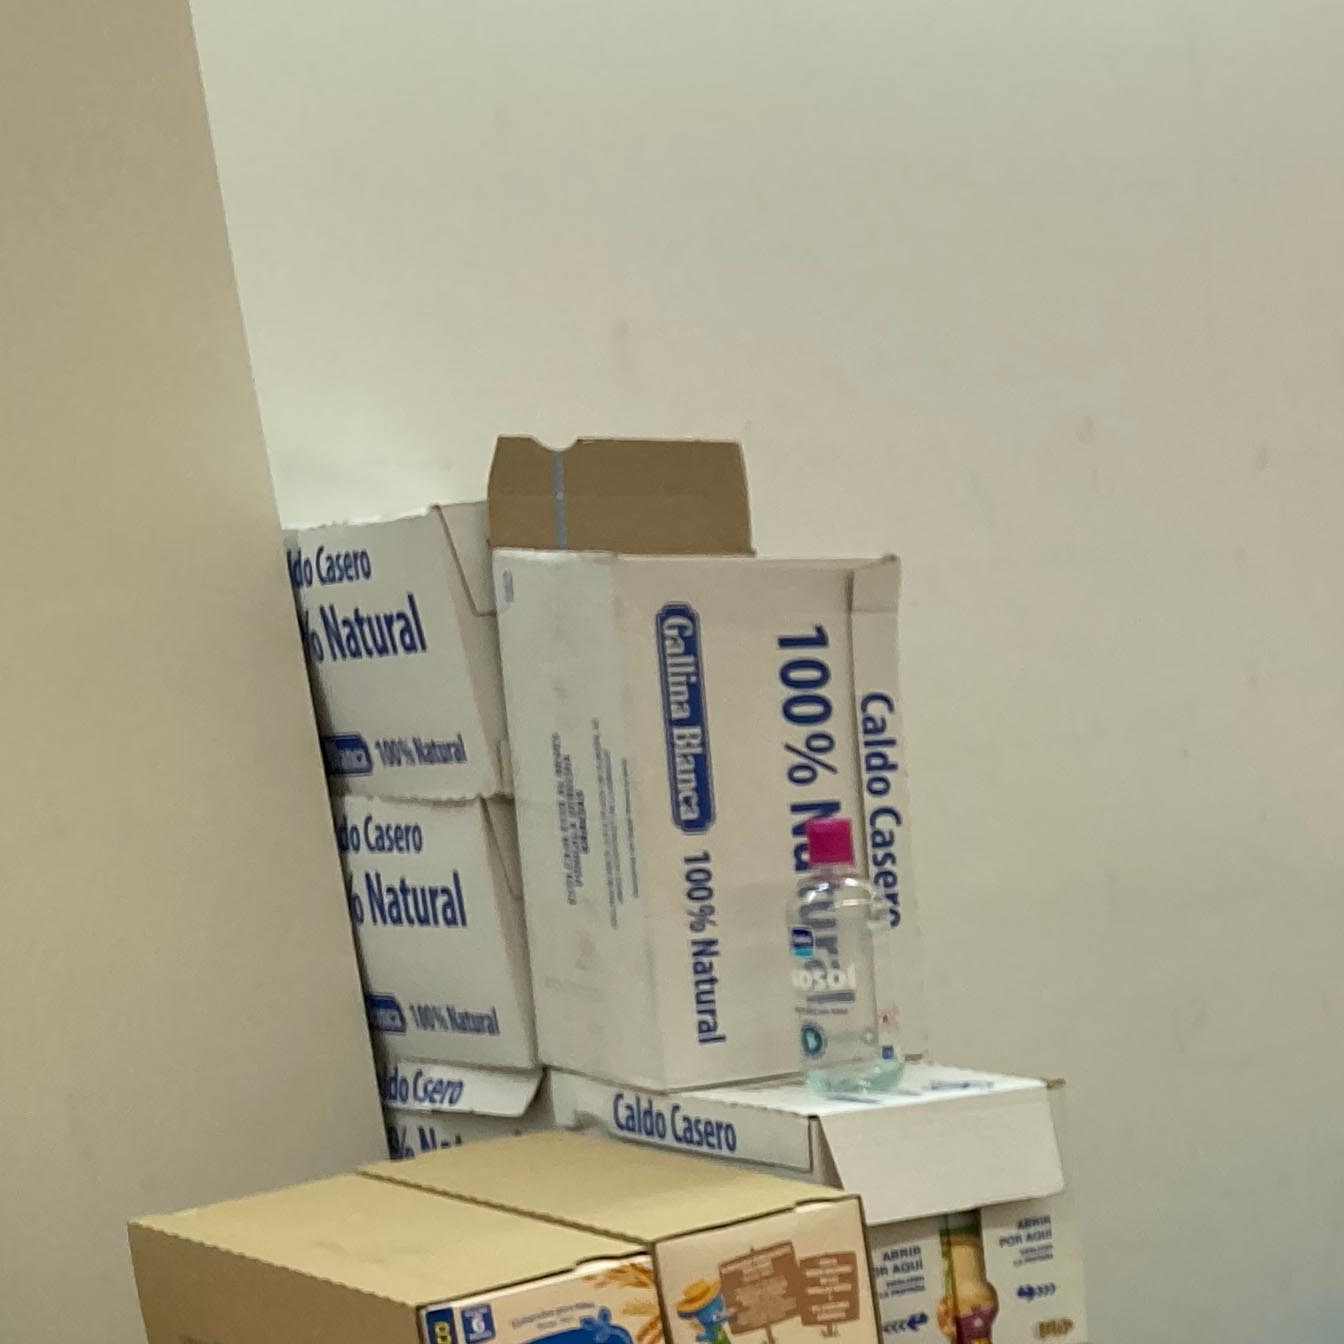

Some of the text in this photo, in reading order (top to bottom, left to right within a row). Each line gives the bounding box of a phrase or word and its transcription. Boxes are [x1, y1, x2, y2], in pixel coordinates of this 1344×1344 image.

[315, 545, 371, 586] Casero
[319, 592, 428, 662] Natural
[662, 614, 706, 822] Gallina Blanca
[776, 624, 838, 786] 100%
[860, 692, 899, 798] Caldo
[363, 814, 424, 853] Casero
[365, 868, 468, 928] Natural
[682, 850, 727, 1045] 100% Natural
[612, 1092, 738, 1154] Caldo Casero
